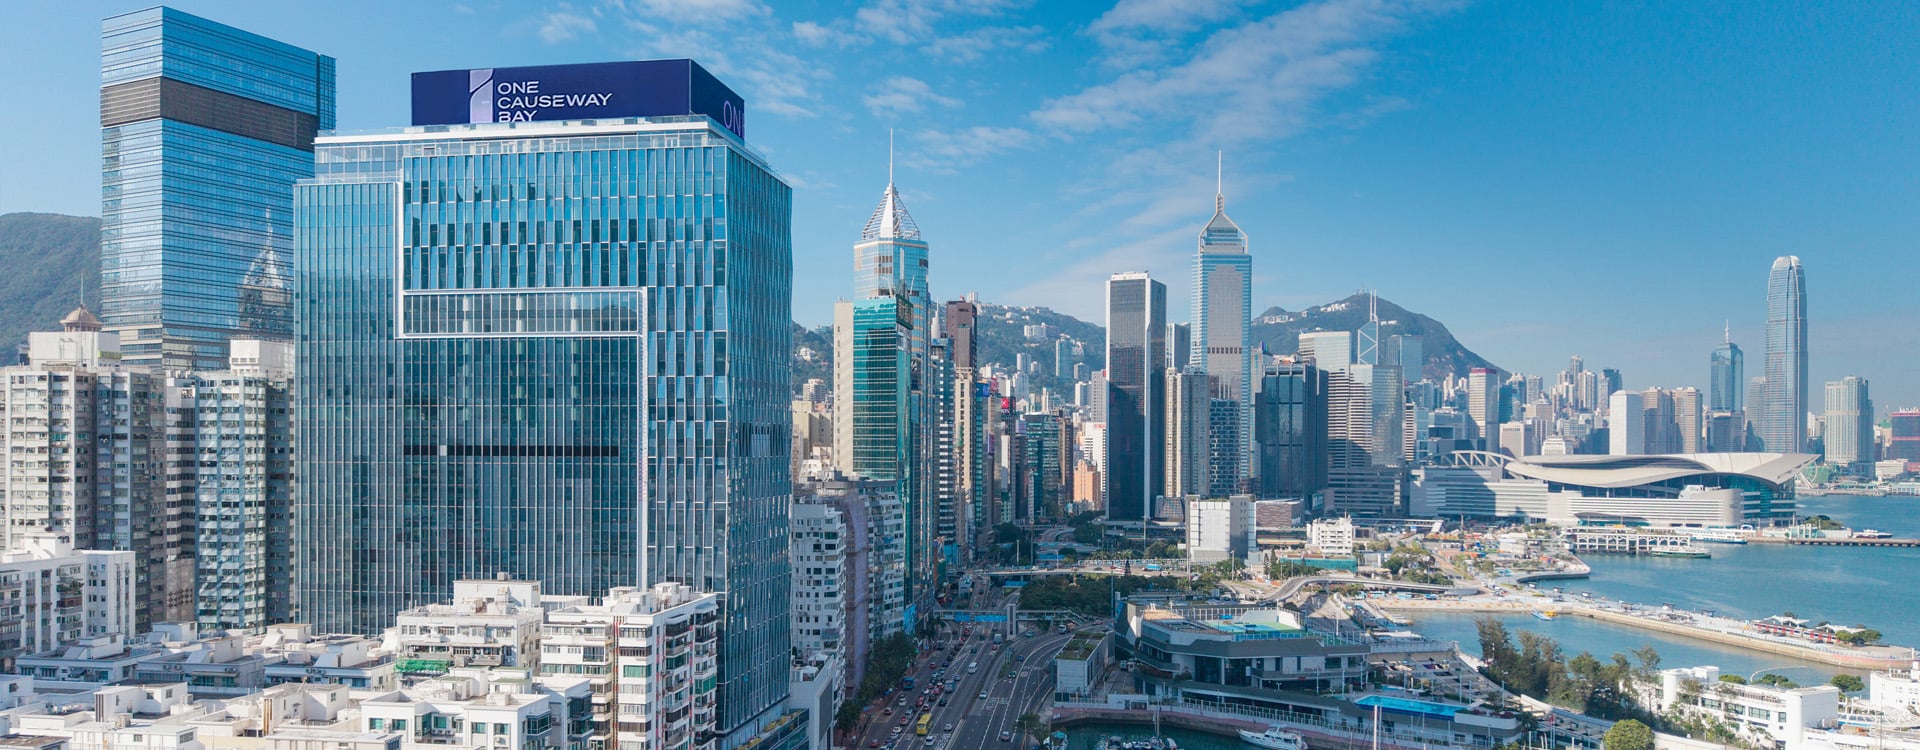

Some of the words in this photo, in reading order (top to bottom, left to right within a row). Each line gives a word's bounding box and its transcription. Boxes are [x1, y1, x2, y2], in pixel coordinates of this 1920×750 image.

[497, 81, 540, 95] ONE
[497, 93, 613, 109] CAUSEWAY
[498, 110, 538, 123] BAY
